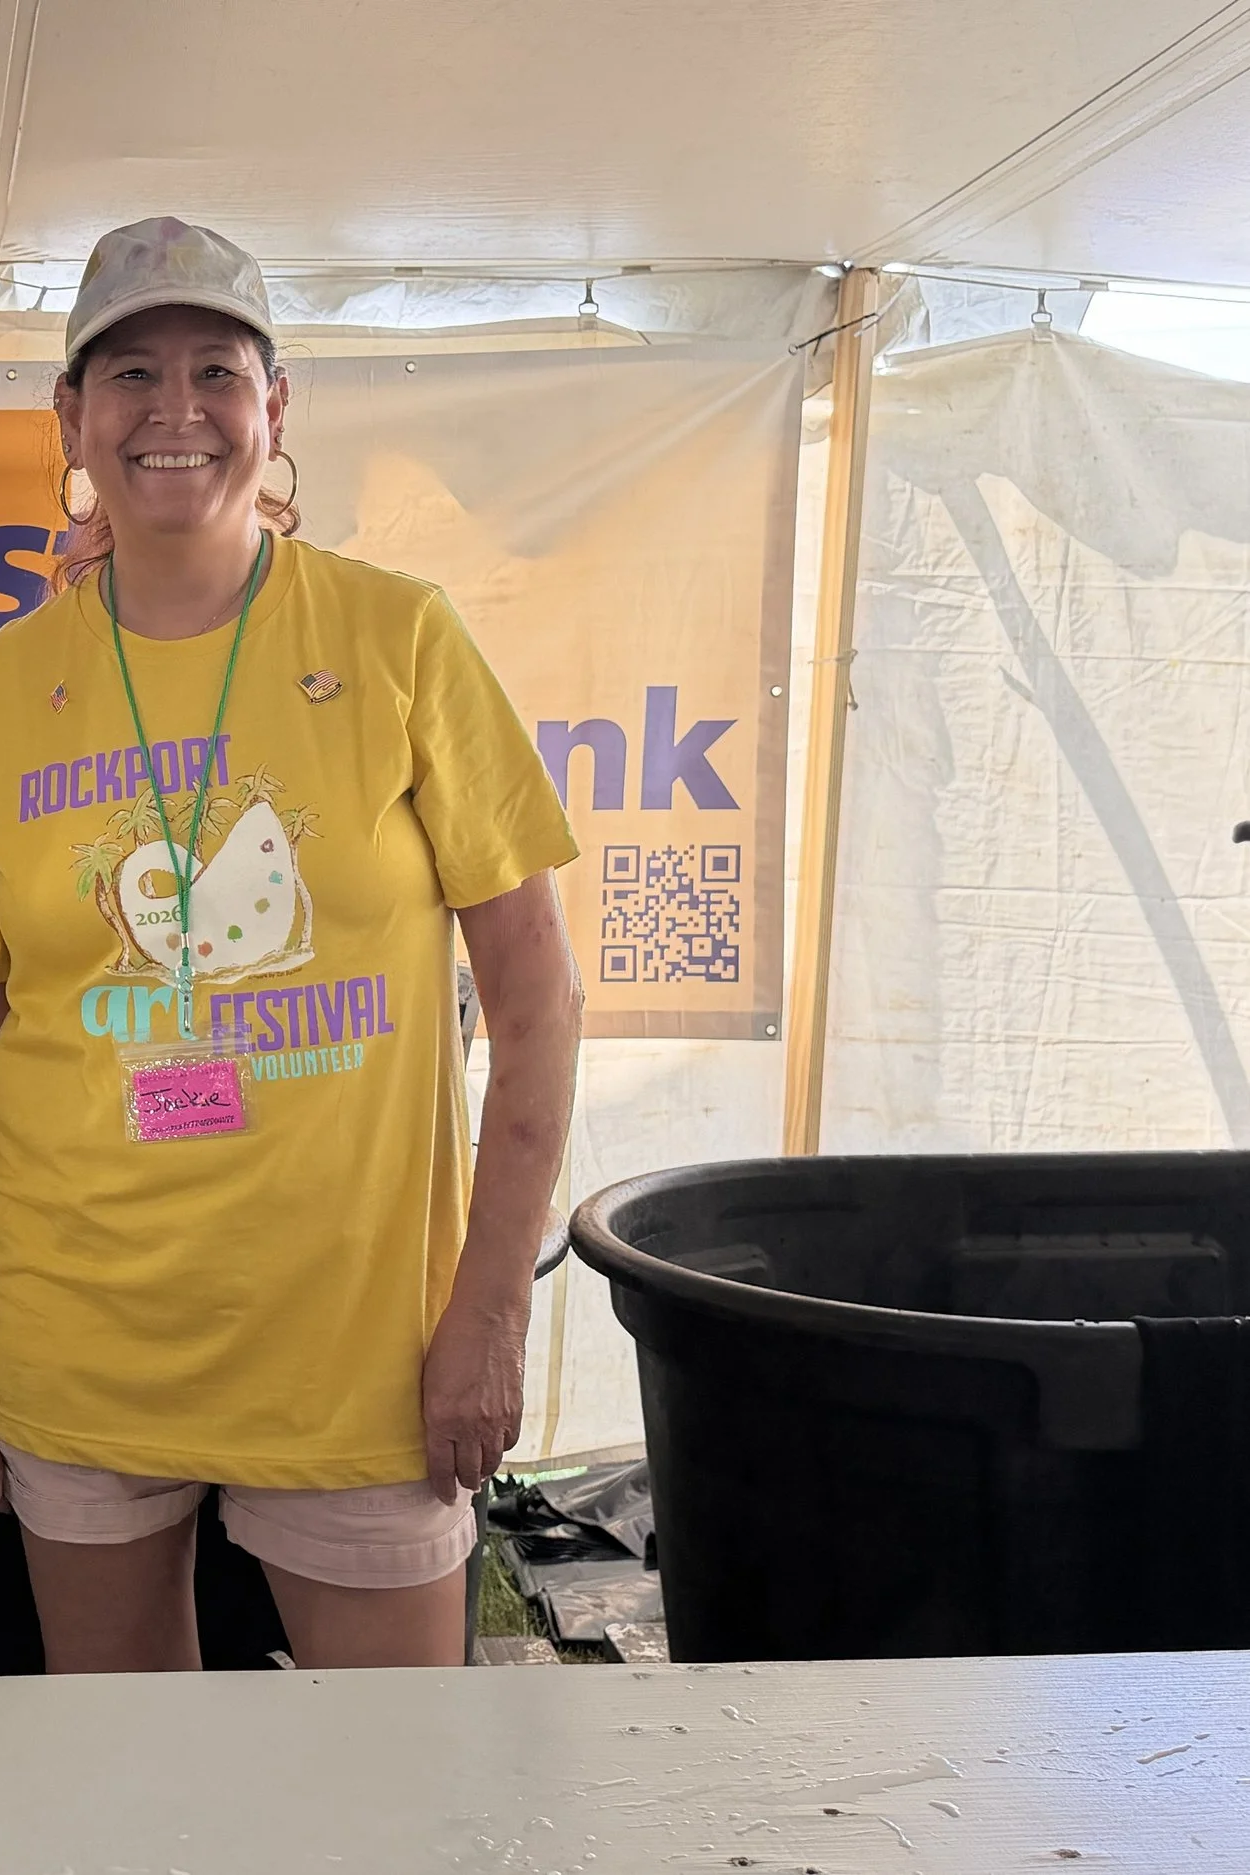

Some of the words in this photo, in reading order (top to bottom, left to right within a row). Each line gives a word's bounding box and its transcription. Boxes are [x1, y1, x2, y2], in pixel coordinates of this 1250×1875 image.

[19, 734, 231, 823] ROCKPORT
[135, 904, 183, 926] 2026
[210, 974, 395, 1055] FESTIVAL
[252, 1042, 364, 1081] VOLUNTEER
[137, 1087, 232, 1114] Jackie
